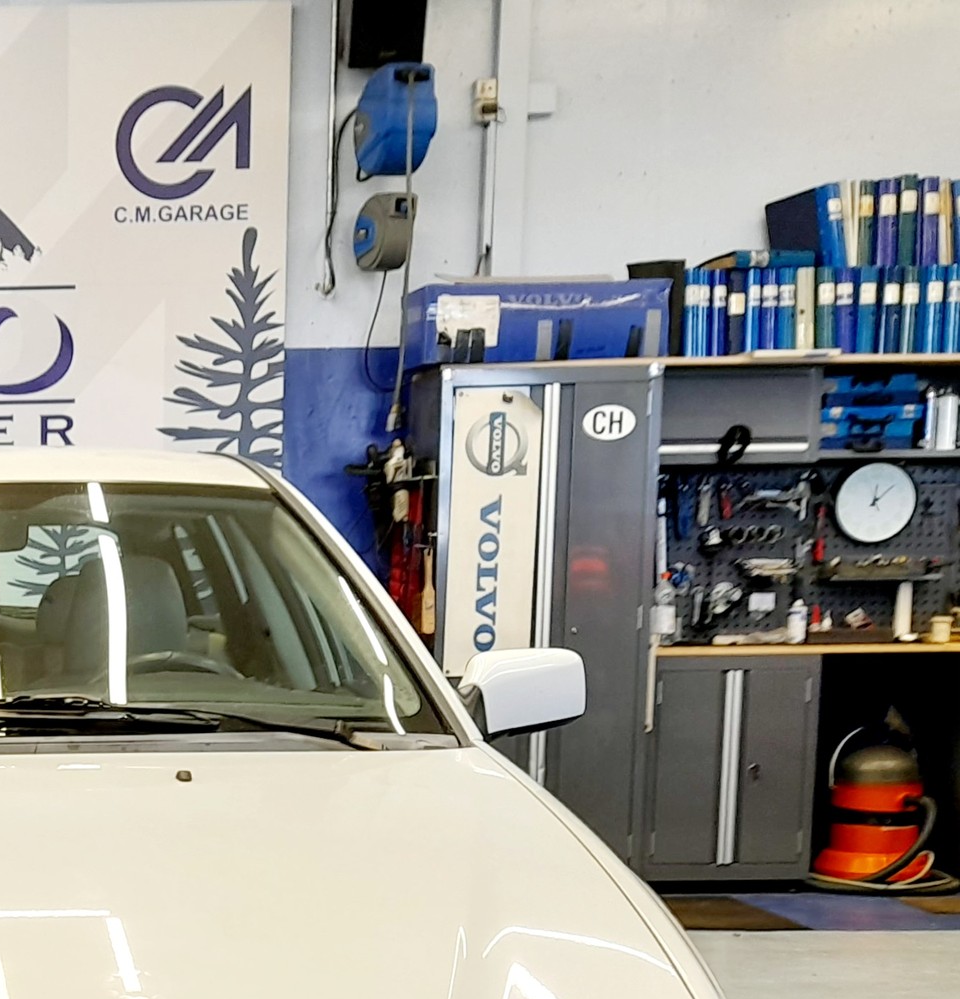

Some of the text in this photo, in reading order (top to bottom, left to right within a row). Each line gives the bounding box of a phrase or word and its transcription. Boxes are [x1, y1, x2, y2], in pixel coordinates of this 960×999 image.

[113, 203, 249, 223] C.M.GARAGE
[490, 414, 504, 473] VOLVO
[592, 410, 624, 435] CH
[473, 495, 502, 652] VOLVO
